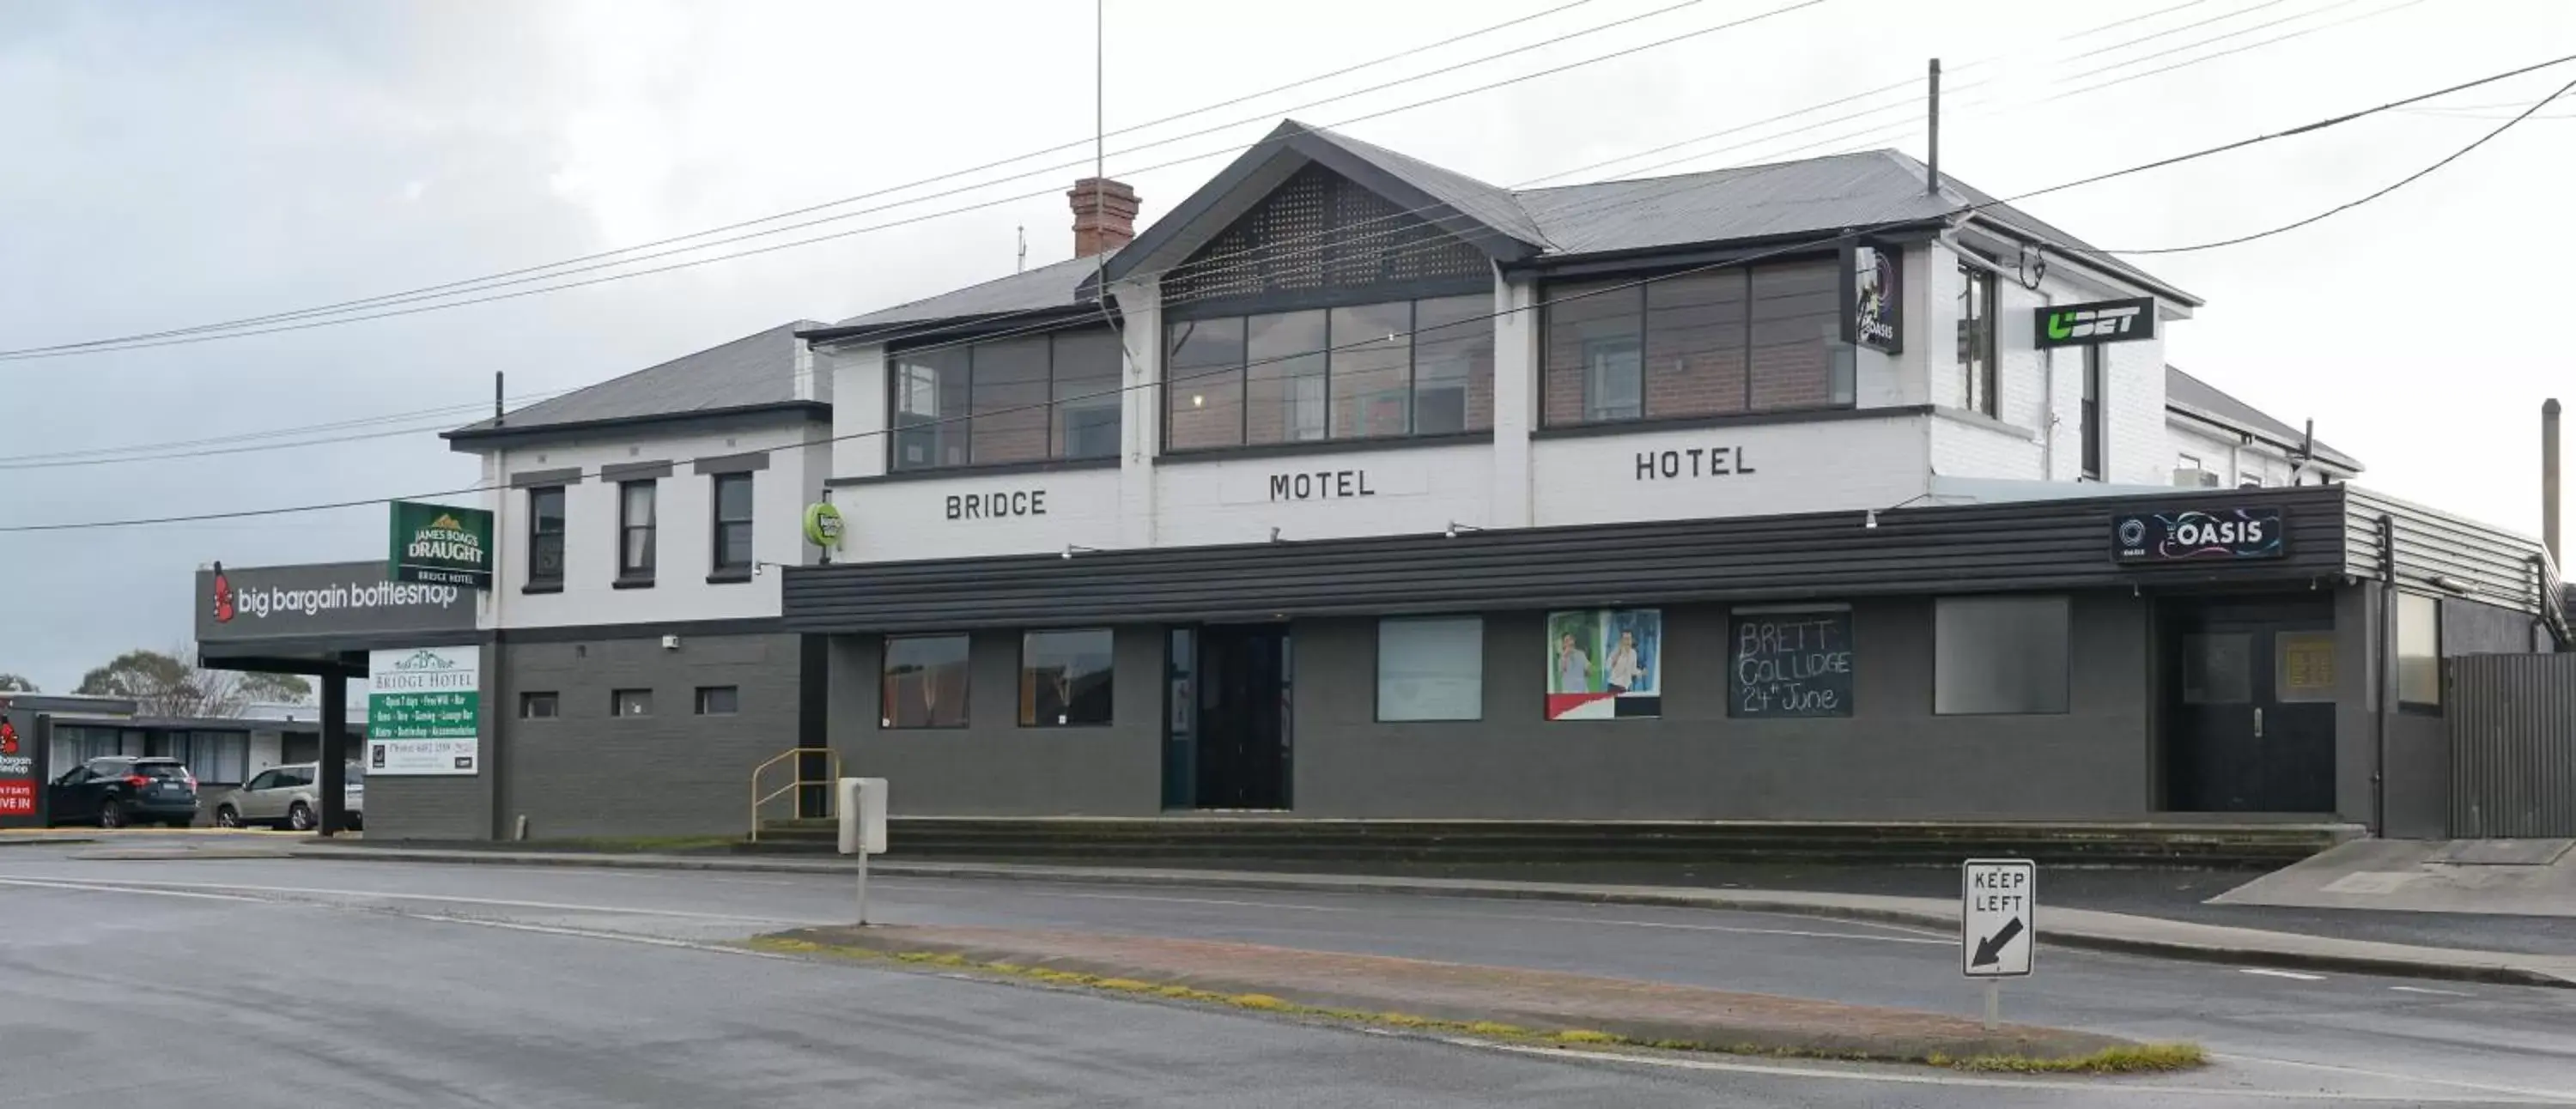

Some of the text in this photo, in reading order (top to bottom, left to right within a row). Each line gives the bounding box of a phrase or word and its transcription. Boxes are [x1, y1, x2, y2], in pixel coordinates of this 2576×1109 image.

[2048, 306, 2141, 339] UBET
[947, 445, 1756, 520] BRIDGE MOTEL HOTEL
[415, 529, 445, 543] JAMES
[2166, 524, 2176, 546] THE
[2177, 520, 2263, 546] OASIS
[409, 541, 484, 563] DRAUGHT
[449, 573, 473, 584] HOTEL
[239, 579, 457, 617] big bargain bottleshop
[1739, 620, 1836, 658] BRETT
[375, 673, 473, 688] BRIDGE HOTEL
[1783, 682, 1838, 710] June
[18, 798, 30, 809] IN
[1976, 872, 2025, 888] KEEP
[1977, 895, 2022, 912] LEFT
